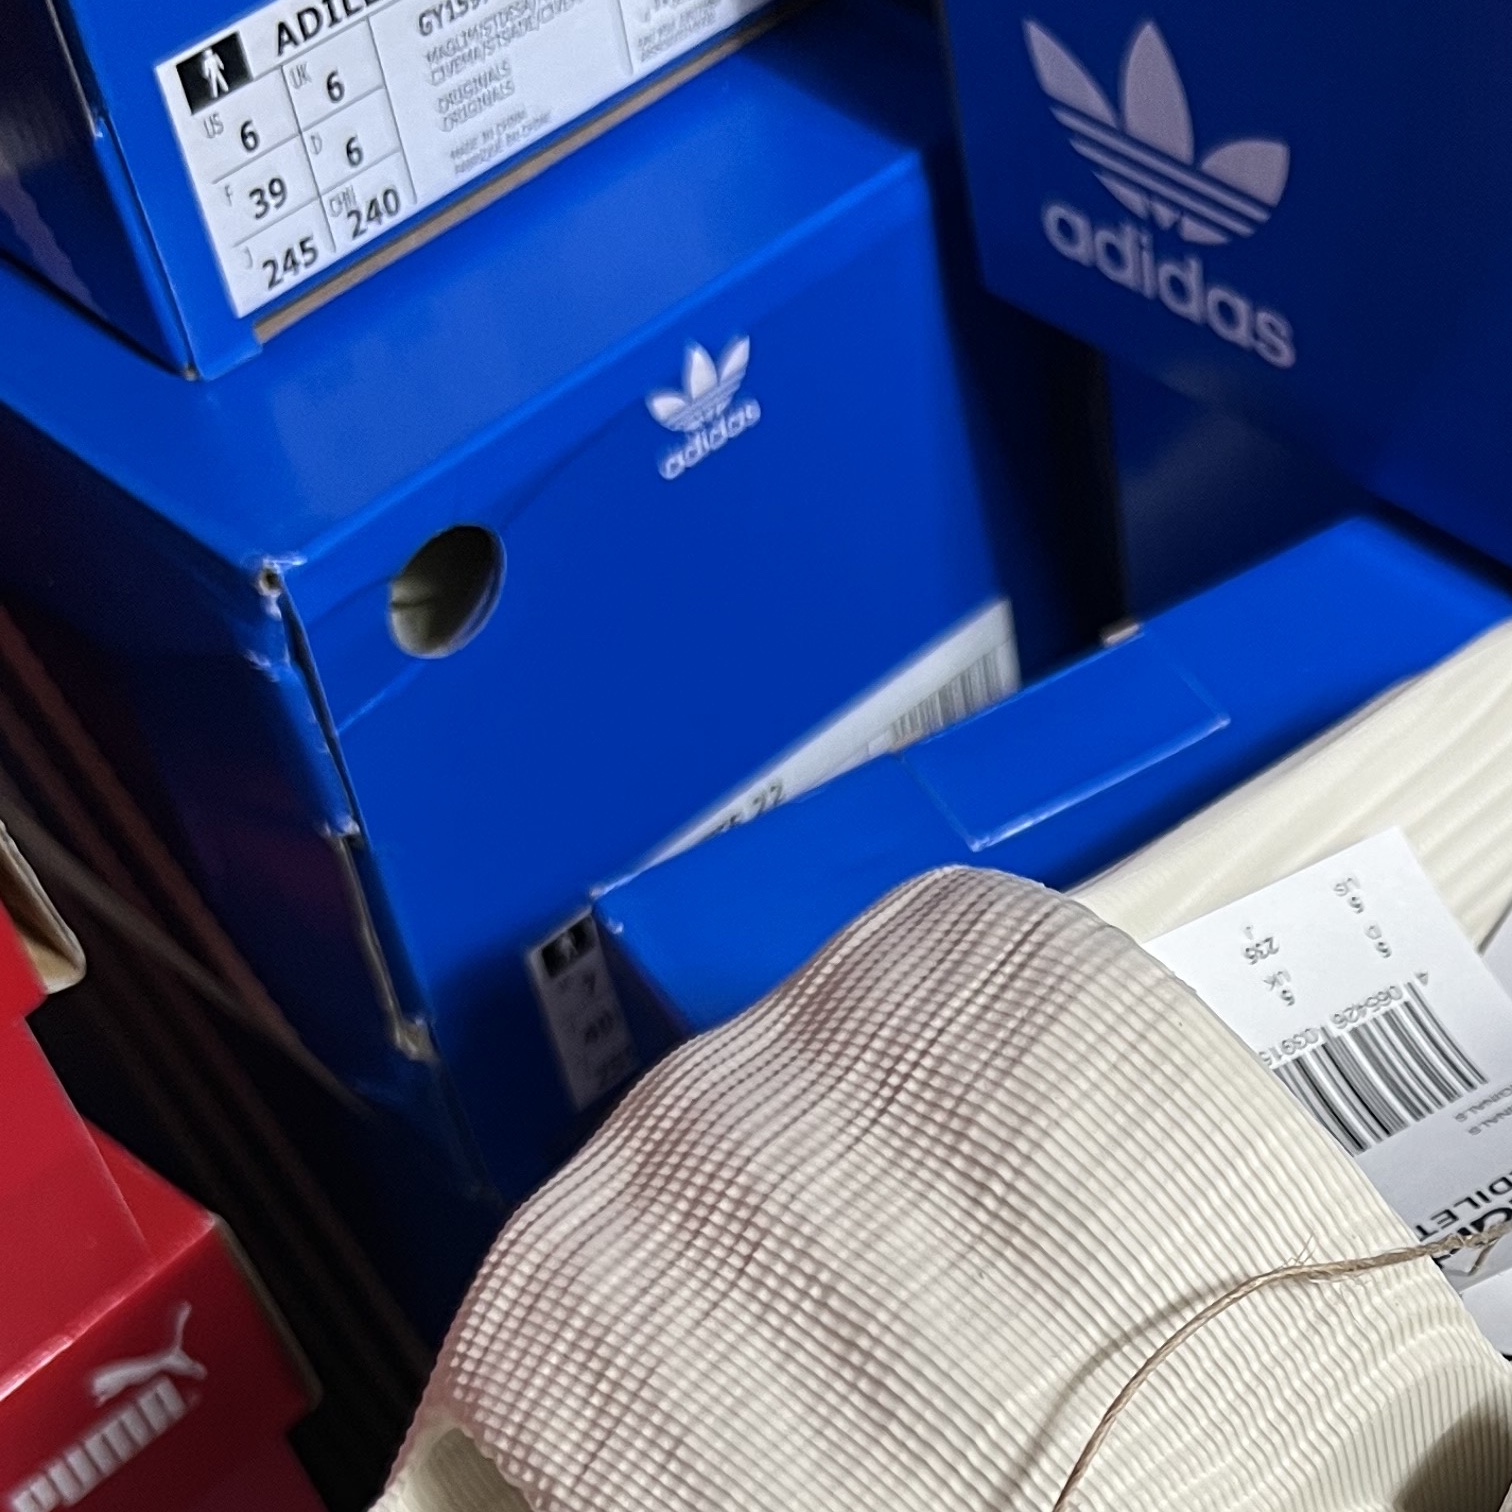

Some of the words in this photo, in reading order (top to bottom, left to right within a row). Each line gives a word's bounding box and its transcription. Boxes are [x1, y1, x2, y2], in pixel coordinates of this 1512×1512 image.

[289, 63, 312, 89] UK
[327, 70, 345, 103] 6
[203, 113, 225, 139] US
[240, 119, 260, 152] 6
[310, 133, 323, 156] D
[346, 136, 364, 168] 6
[249, 177, 288, 220] 39
[347, 188, 400, 241] 240
[262, 234, 320, 290] 245
[1042, 202, 1296, 368] adidas
[659, 400, 761, 480] adidas
[1333, 876, 1361, 897] US
[1349, 896, 1364, 914] 5
[1244, 936, 1280, 966] 235
[1364, 923, 1382, 940] D
[1375, 941, 1392, 959] 5
[1263, 970, 1292, 993] UK
[1281, 988, 1296, 1007] 5
[1331, 985, 1404, 1030] 065426
